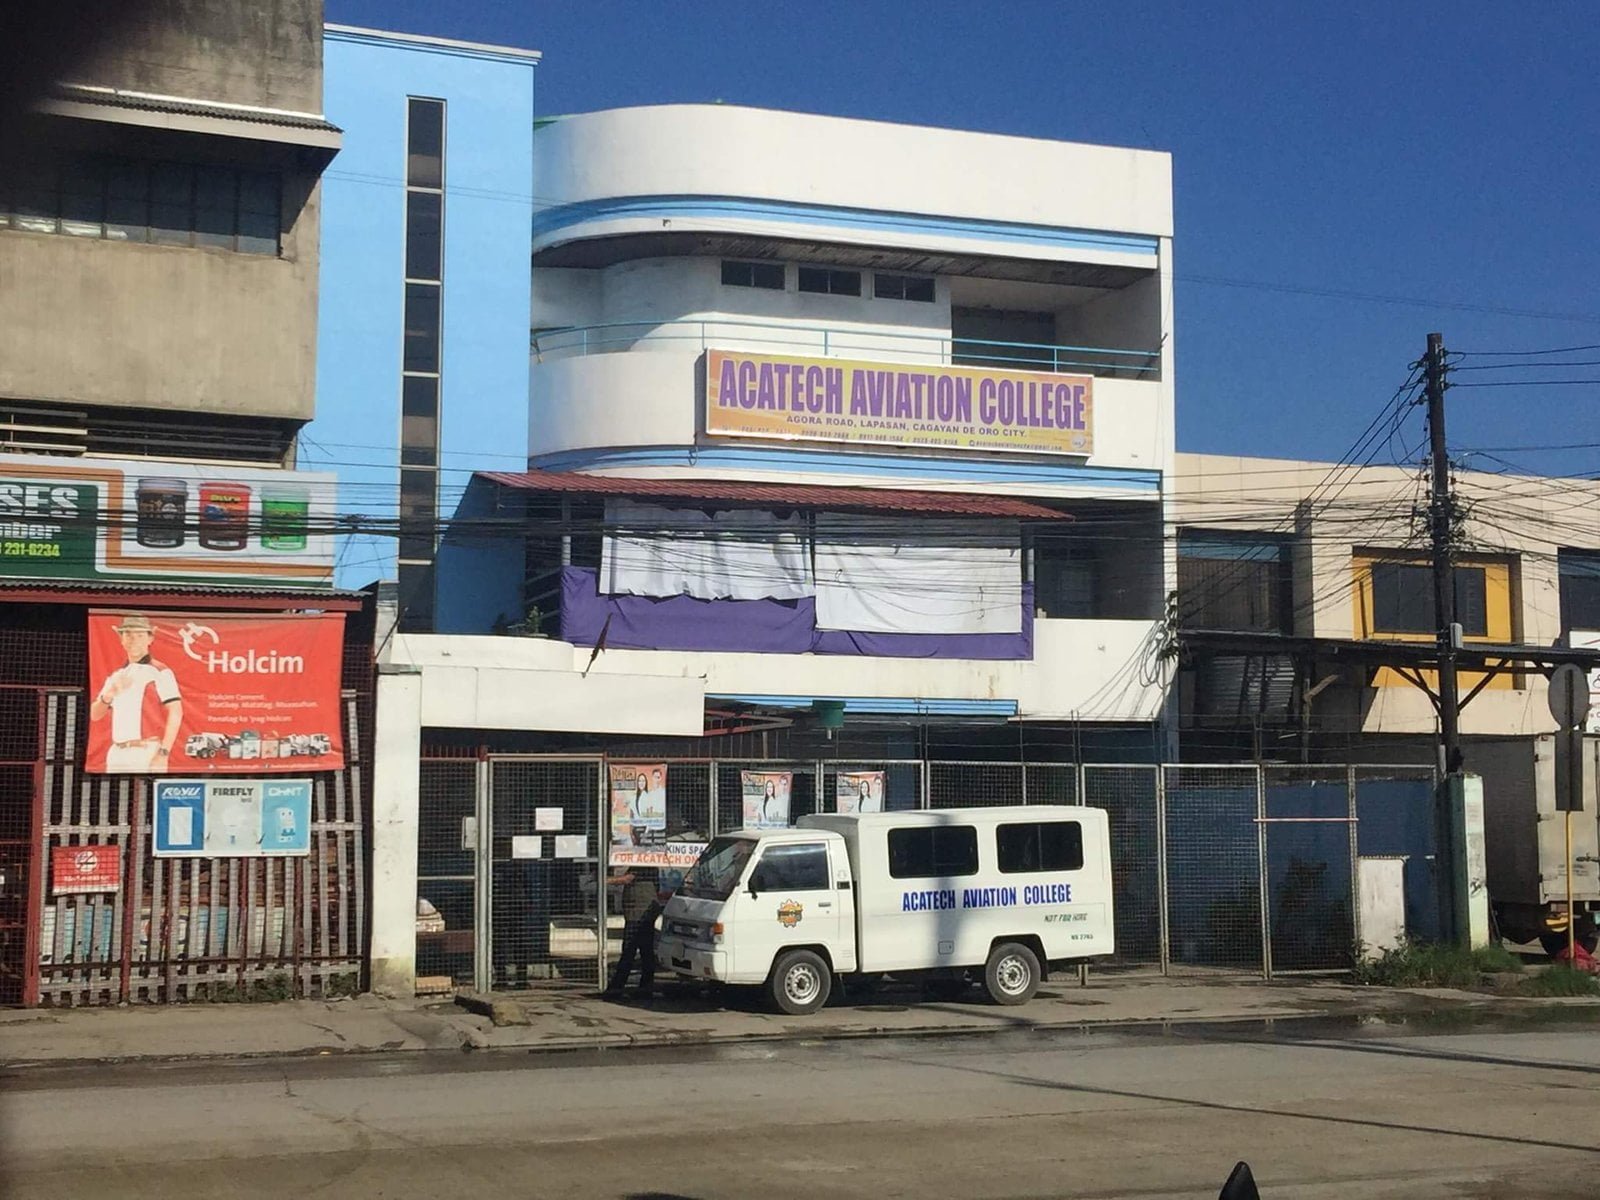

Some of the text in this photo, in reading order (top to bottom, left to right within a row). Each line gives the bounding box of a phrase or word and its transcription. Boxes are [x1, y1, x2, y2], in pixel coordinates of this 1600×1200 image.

[718, 358, 1086, 430] ACATECH AVIATION COLLEGE
[786, 415, 823, 425] AGORA
[825, 417, 857, 428] ROAD,
[860, 419, 909, 431] LAPASAN,
[912, 423, 959, 433] CAGAYAN
[963, 427, 976, 435] DE
[979, 427, 1000, 436] ORO
[207, 649, 304, 674] Holcim
[212, 787, 254, 796] FIREFLY
[614, 853, 634, 863] FOR
[637, 854, 682, 864] ACATECH
[902, 884, 1072, 912] ACATECH AVIATION COLLEGE
[1044, 914, 1058, 923] NOT
[1059, 913, 1072, 922] FOR
